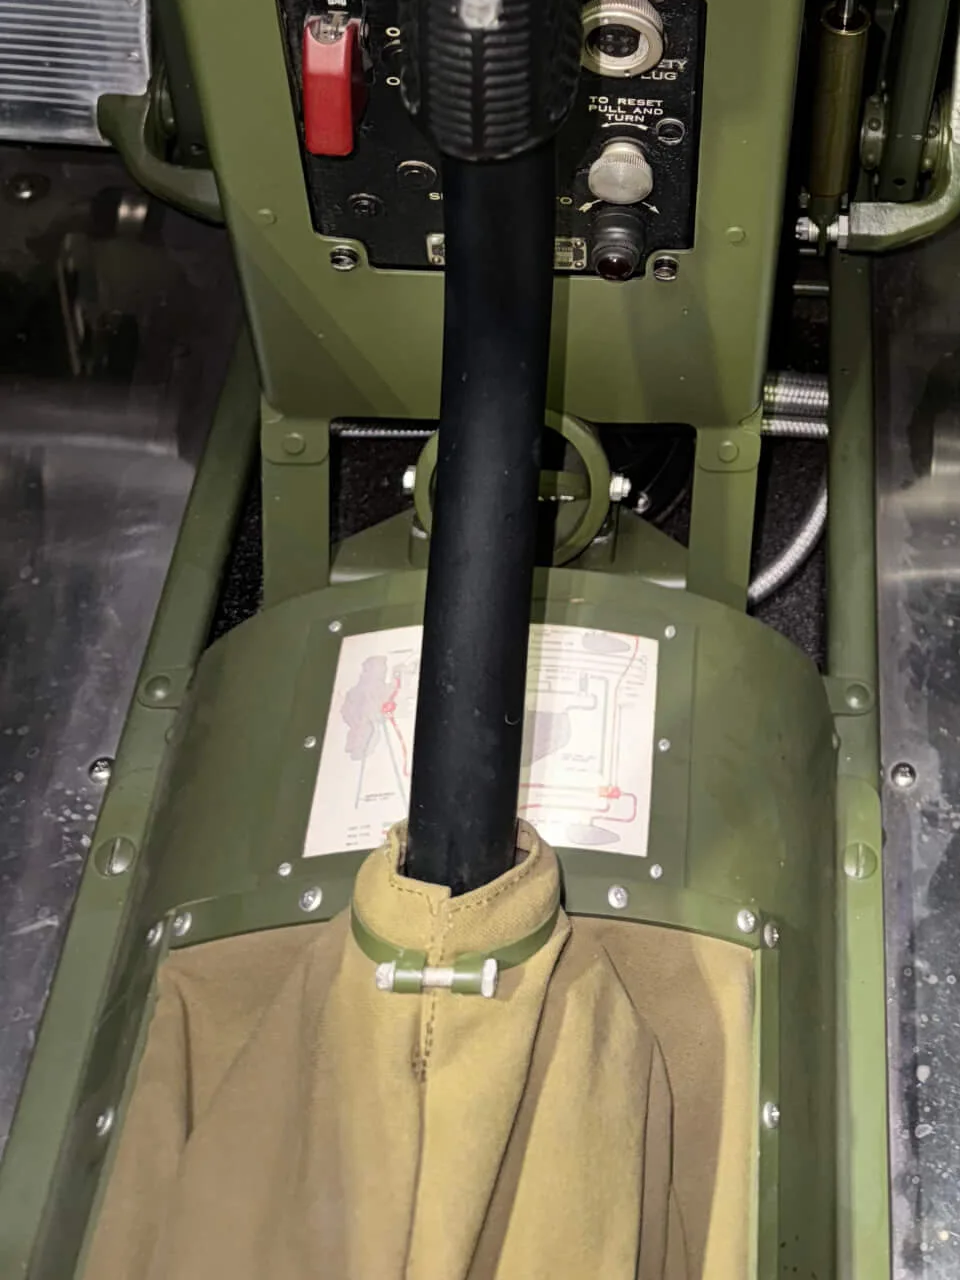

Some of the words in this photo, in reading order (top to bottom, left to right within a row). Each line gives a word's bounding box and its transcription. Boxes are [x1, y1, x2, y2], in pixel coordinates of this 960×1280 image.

[657, 59, 688, 71] ETY
[589, 96, 609, 104] TO
[617, 98, 664, 107] RESET
[588, 105, 627, 113] PULL
[632, 107, 664, 116] AND
[605, 114, 645, 122] TURN
